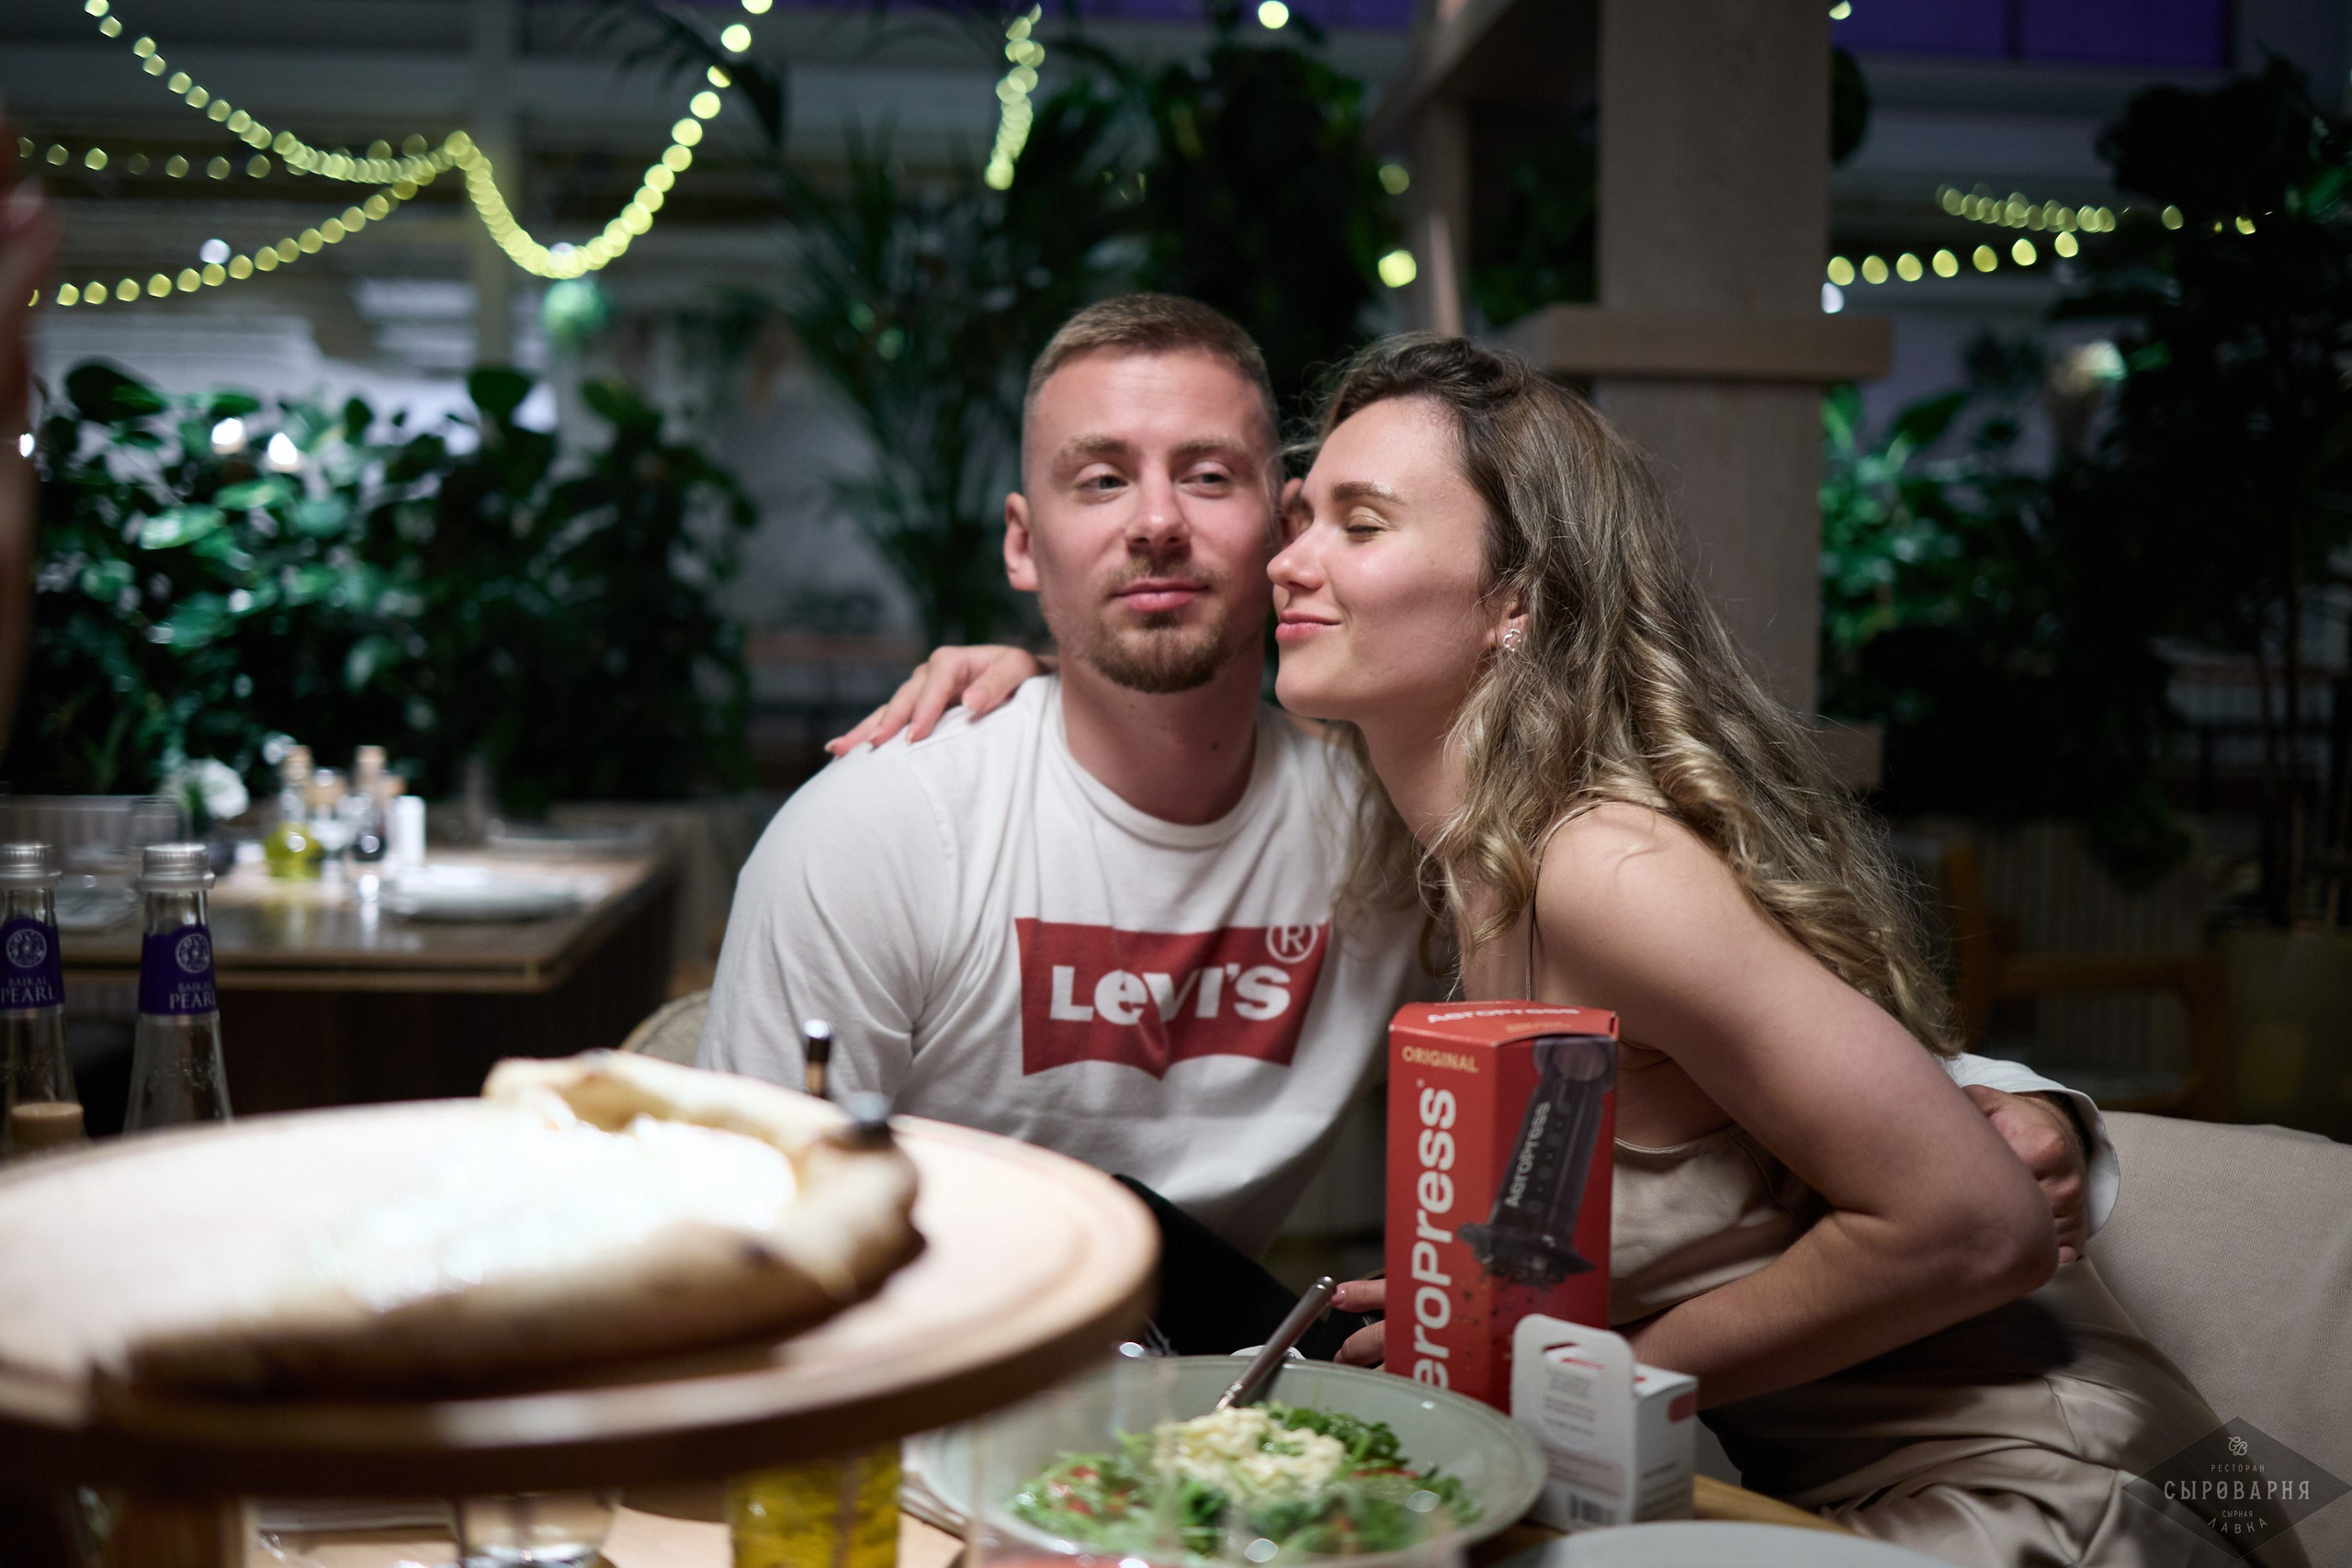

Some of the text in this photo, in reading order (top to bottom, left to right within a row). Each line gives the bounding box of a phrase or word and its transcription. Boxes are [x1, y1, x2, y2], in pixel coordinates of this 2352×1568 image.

[0, 985, 55, 1003] PEARL
[1401, 1045, 1479, 1073] ORIGINAL
[1412, 1087, 1457, 1390] eroPress
